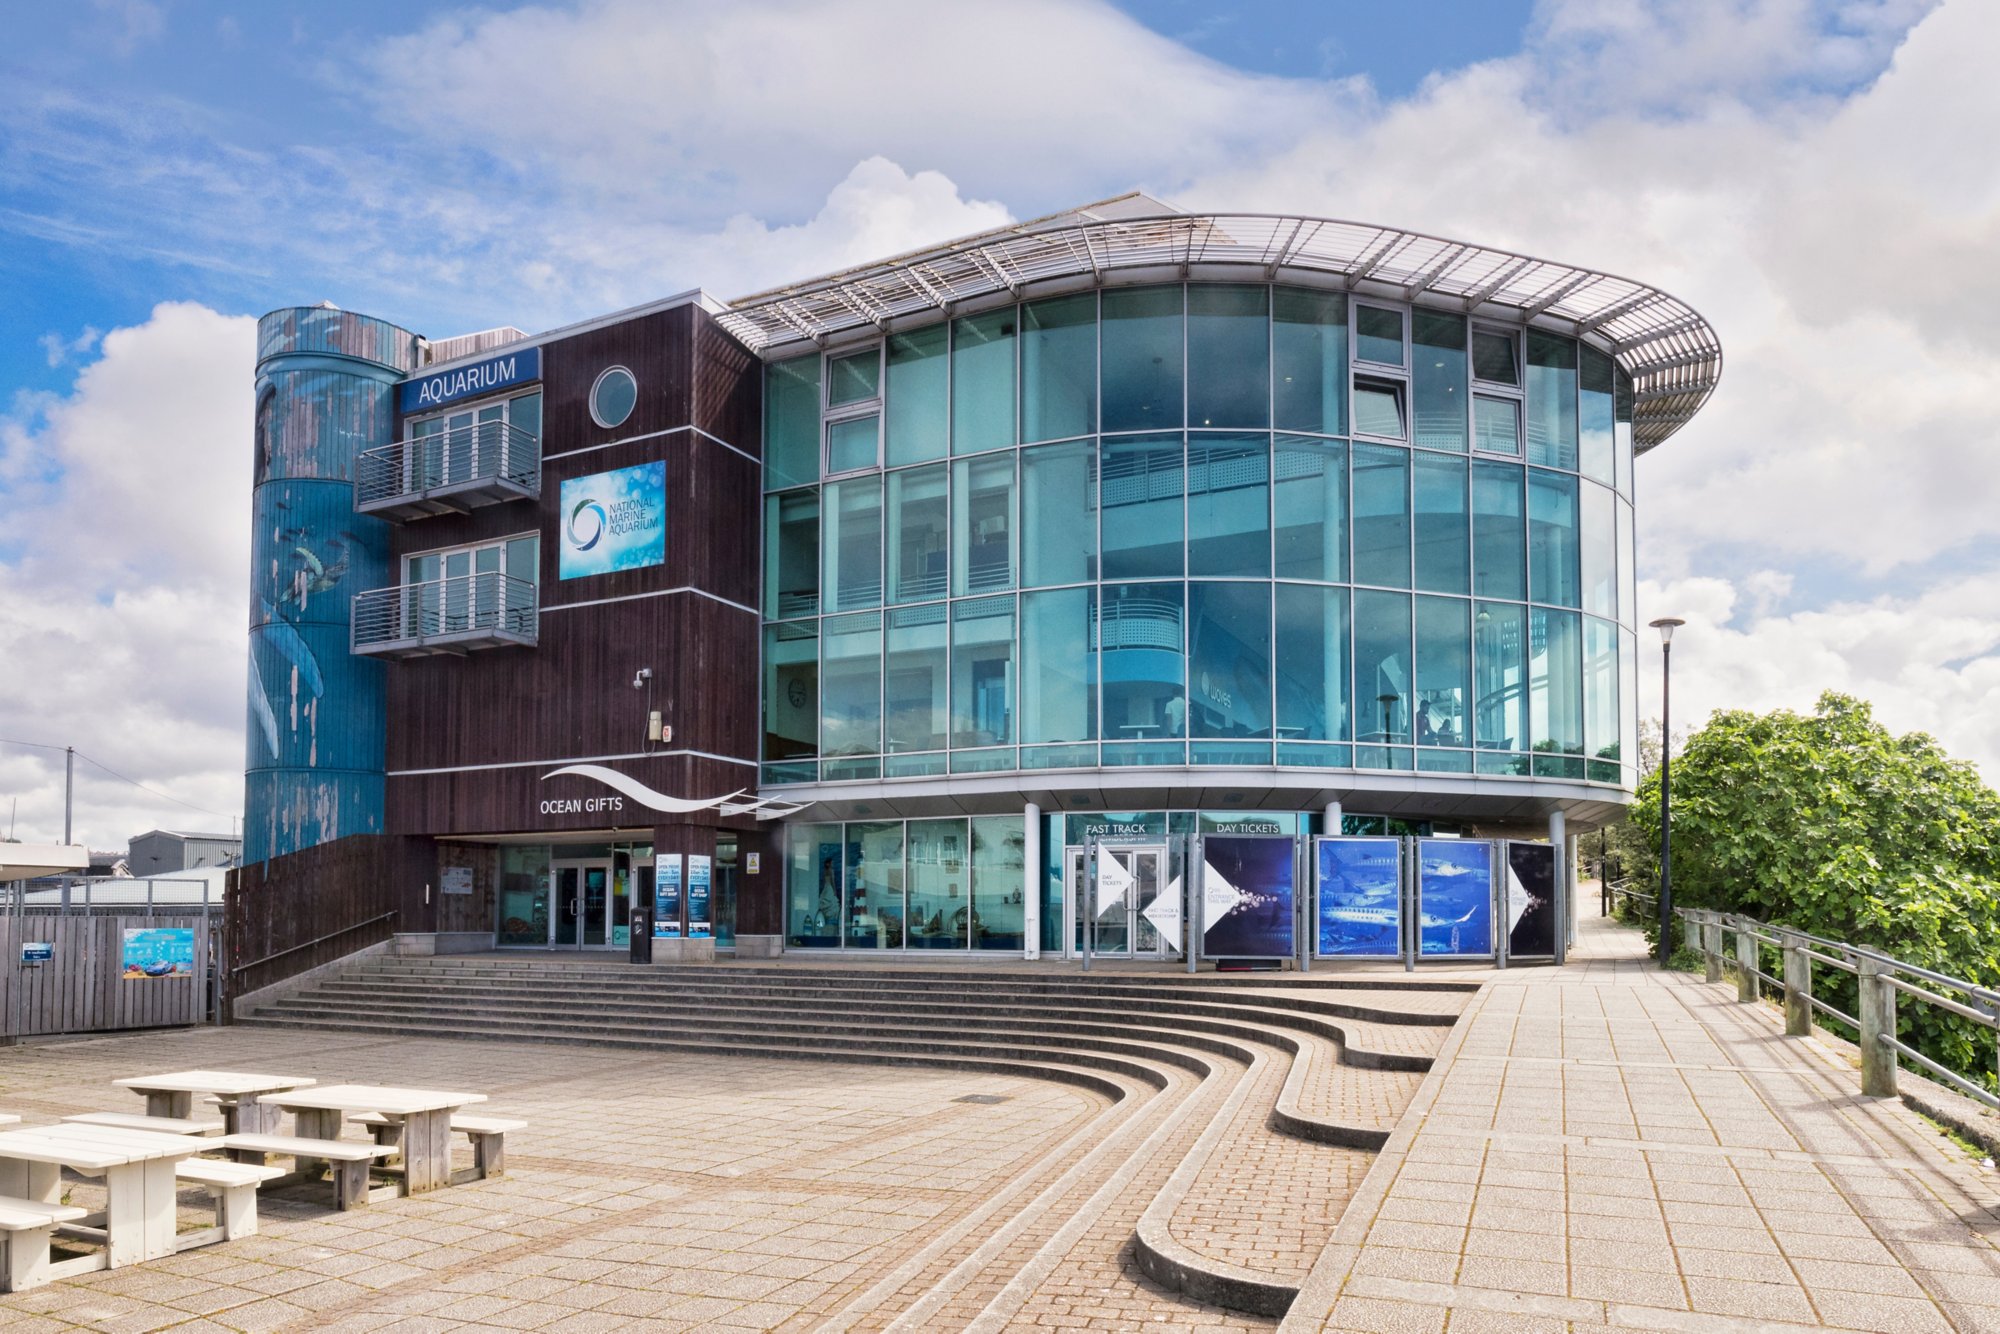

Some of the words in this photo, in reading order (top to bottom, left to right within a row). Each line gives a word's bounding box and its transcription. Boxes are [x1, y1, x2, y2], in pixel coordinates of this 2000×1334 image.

[419, 357, 515, 404] AQUARIUM
[609, 496, 655, 514] NATIONAL
[609, 508, 646, 525] MARINE
[608, 517, 658, 537] AQUARIUM
[540, 799, 581, 814] OCEAN
[585, 797, 623, 812] GIFTS
[1086, 824, 1110, 834] FAST
[1113, 823, 1146, 834] TRACK
[1216, 823, 1237, 833] DAY
[1240, 823, 1279, 833] TICKETS
